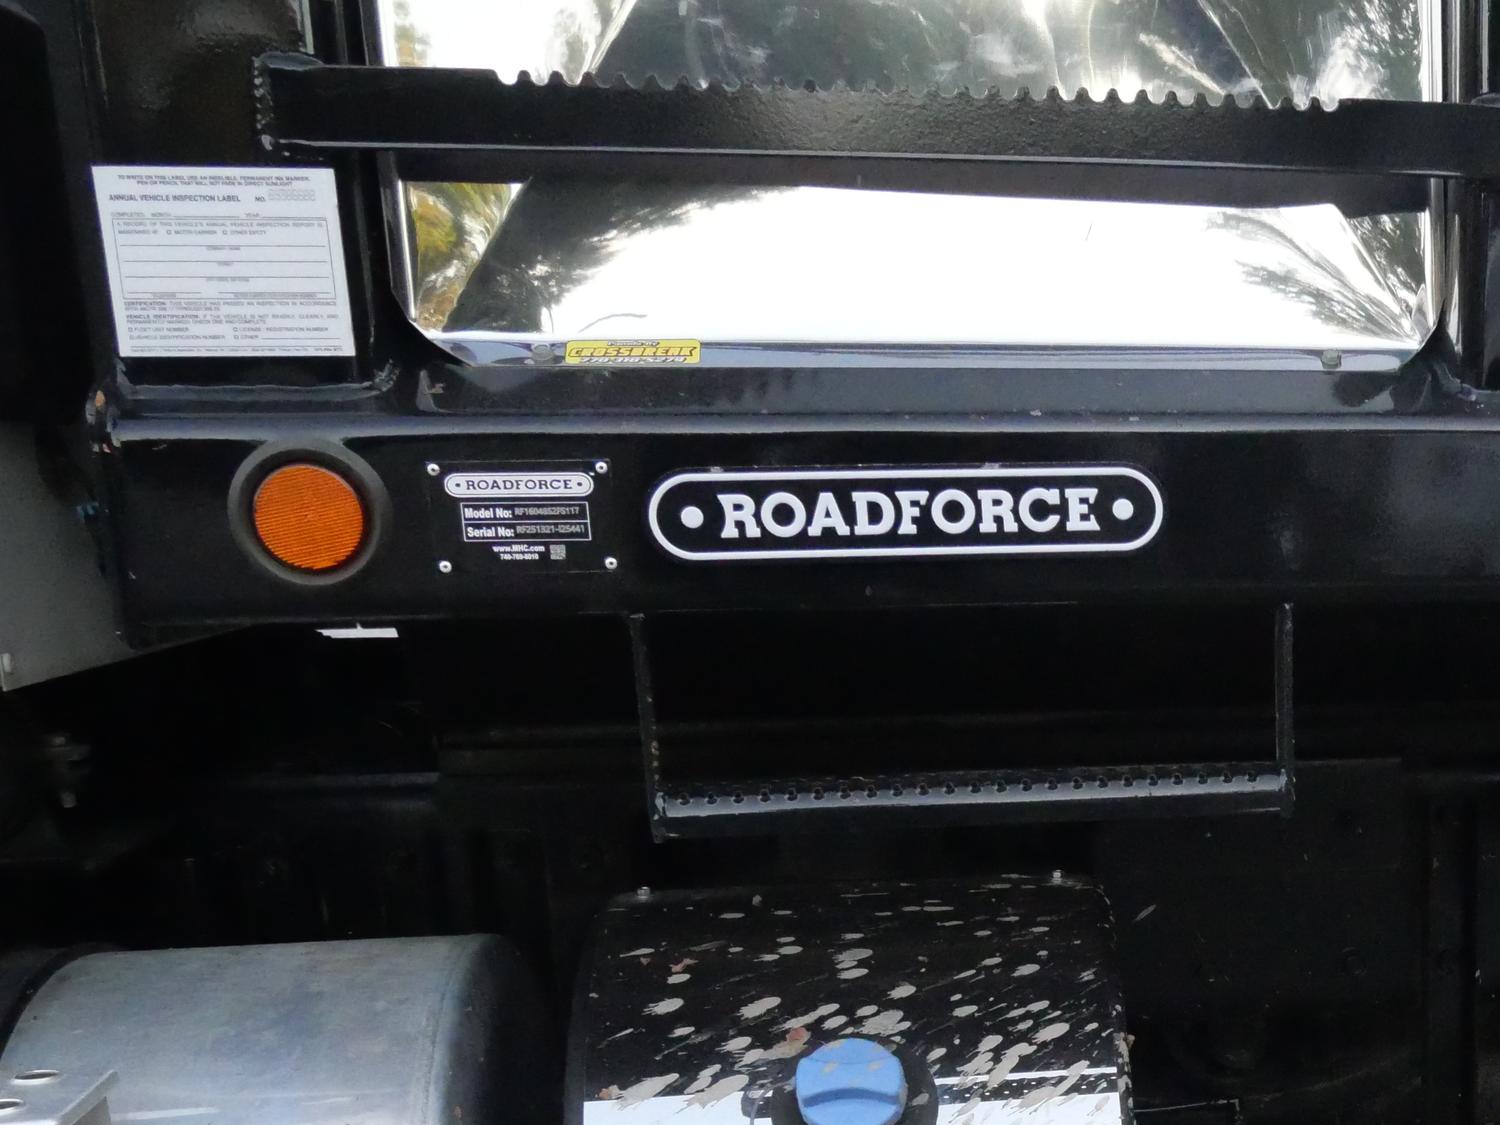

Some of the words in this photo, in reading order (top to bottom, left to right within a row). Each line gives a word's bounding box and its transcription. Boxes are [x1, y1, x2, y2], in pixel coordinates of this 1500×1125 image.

[568, 347, 697, 357] CROSSBREAK
[466, 479, 573, 490] ROADFORCE
[464, 508, 494, 518] Model
[496, 508, 512, 518] No:
[716, 488, 1100, 538] ROADFORCE
[467, 527, 495, 537] Serial
[498, 527, 514, 537] No:
